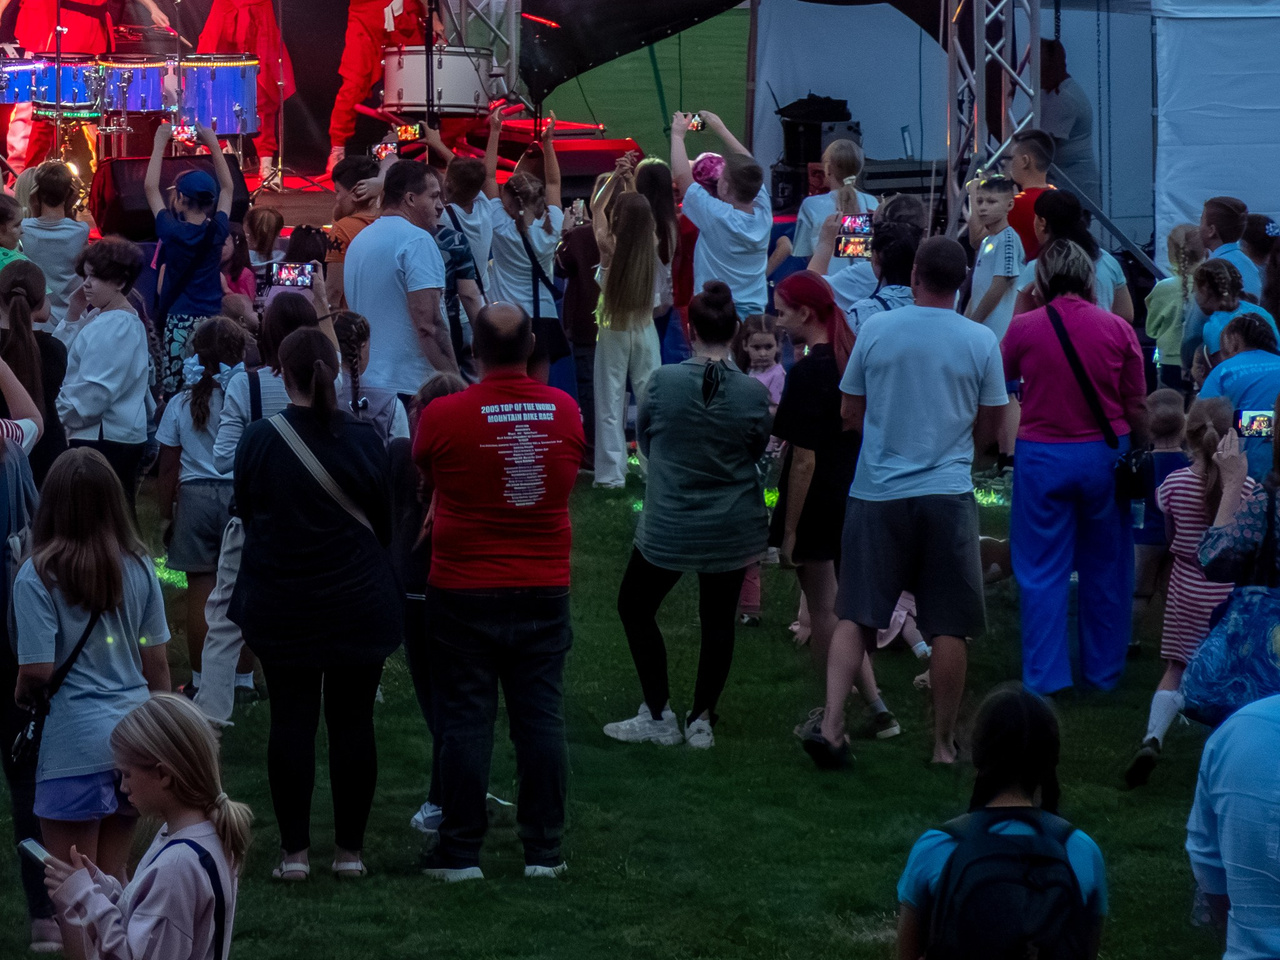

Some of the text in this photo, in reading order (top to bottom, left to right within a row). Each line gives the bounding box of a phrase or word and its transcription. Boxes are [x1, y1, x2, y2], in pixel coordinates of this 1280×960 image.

[500, 404, 513, 412] TOP
[514, 403, 522, 411] OF
[523, 403, 535, 411] THE
[535, 403, 556, 411] WORLD
[488, 412, 554, 423] MOUNTAIN BIKE RACE
